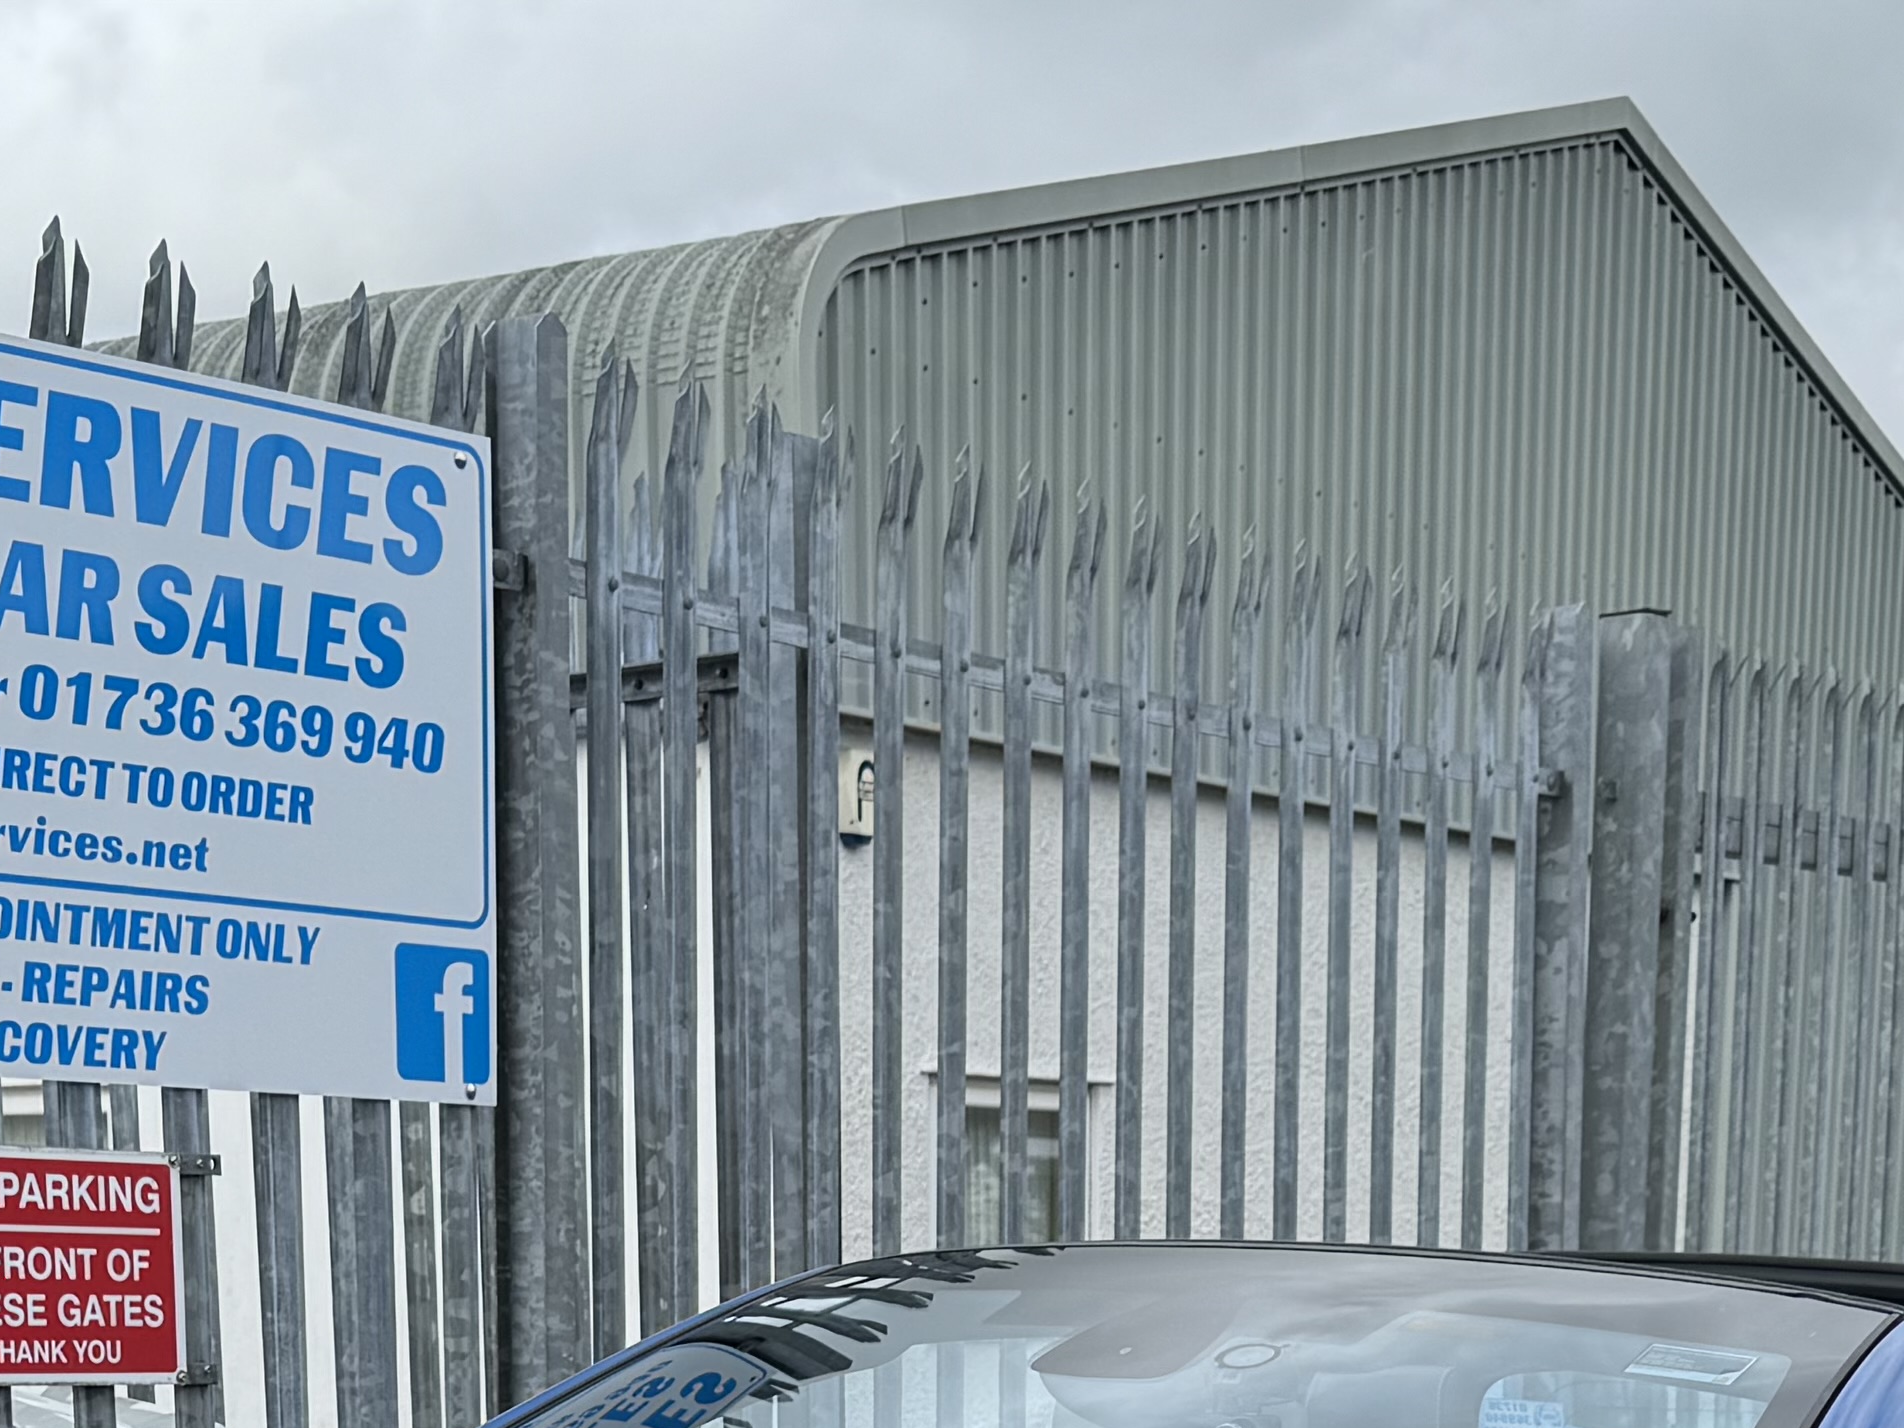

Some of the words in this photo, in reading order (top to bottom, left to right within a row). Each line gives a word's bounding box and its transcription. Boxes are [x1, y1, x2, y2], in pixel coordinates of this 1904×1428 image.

[134, 564, 408, 690] SALES
[18, 663, 216, 743] 01736
[225, 694, 335, 760] 369
[343, 711, 446, 775] 940
[122, 763, 176, 810] TO
[180, 770, 315, 826] ORDER
[215, 918, 321, 967] ONLY
[21, 961, 210, 1016] REPAIRS
[106, 1248, 150, 1282] OF
[57, 1293, 164, 1328] GATES
[73, 1340, 122, 1364] YOU
